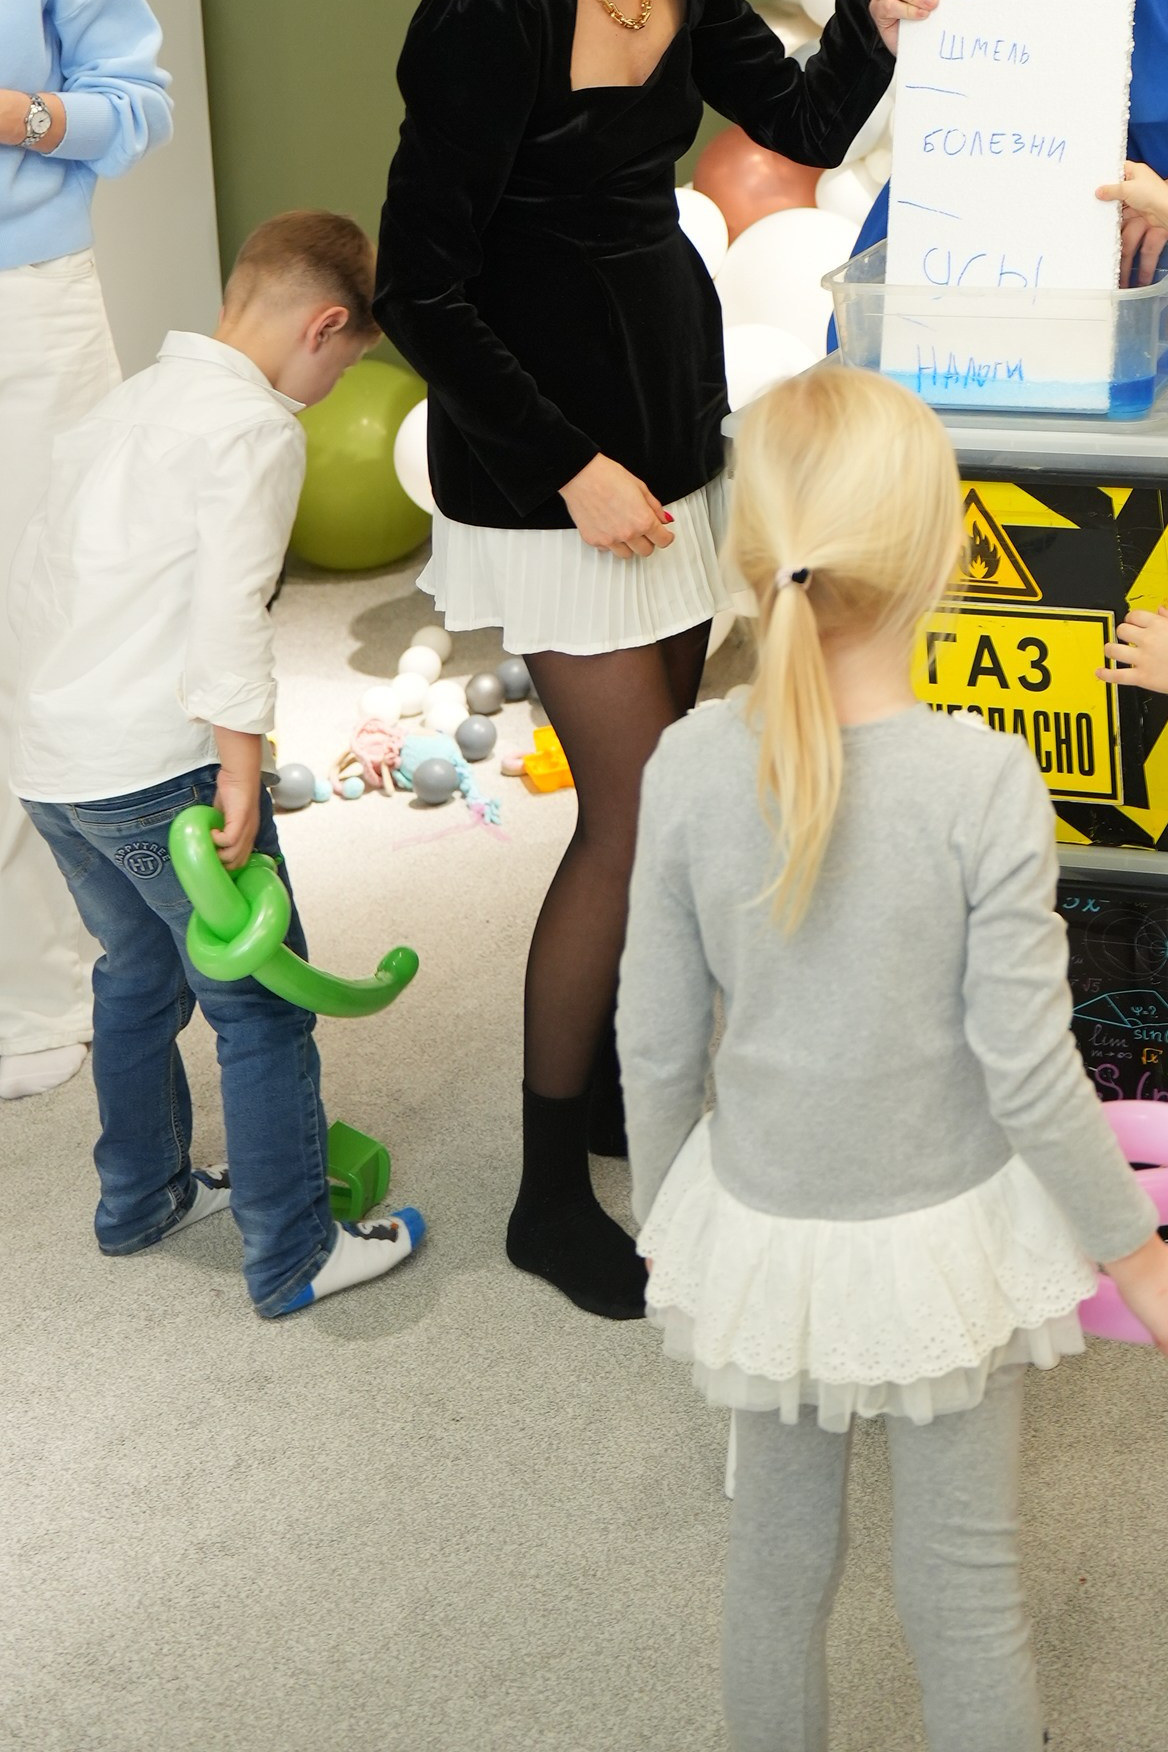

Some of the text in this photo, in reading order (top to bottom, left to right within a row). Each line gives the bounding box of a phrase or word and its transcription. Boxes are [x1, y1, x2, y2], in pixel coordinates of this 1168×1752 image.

[939, 29, 1031, 65] ШМЕЛЬ
[922, 127, 1067, 163] БОЛЕЗНИ
[923, 246, 1044, 306] УСЫ
[916, 343, 1025, 394] НАЛОГИ
[925, 631, 1052, 693] ГАЗ
[128, 856, 155, 872] HT
